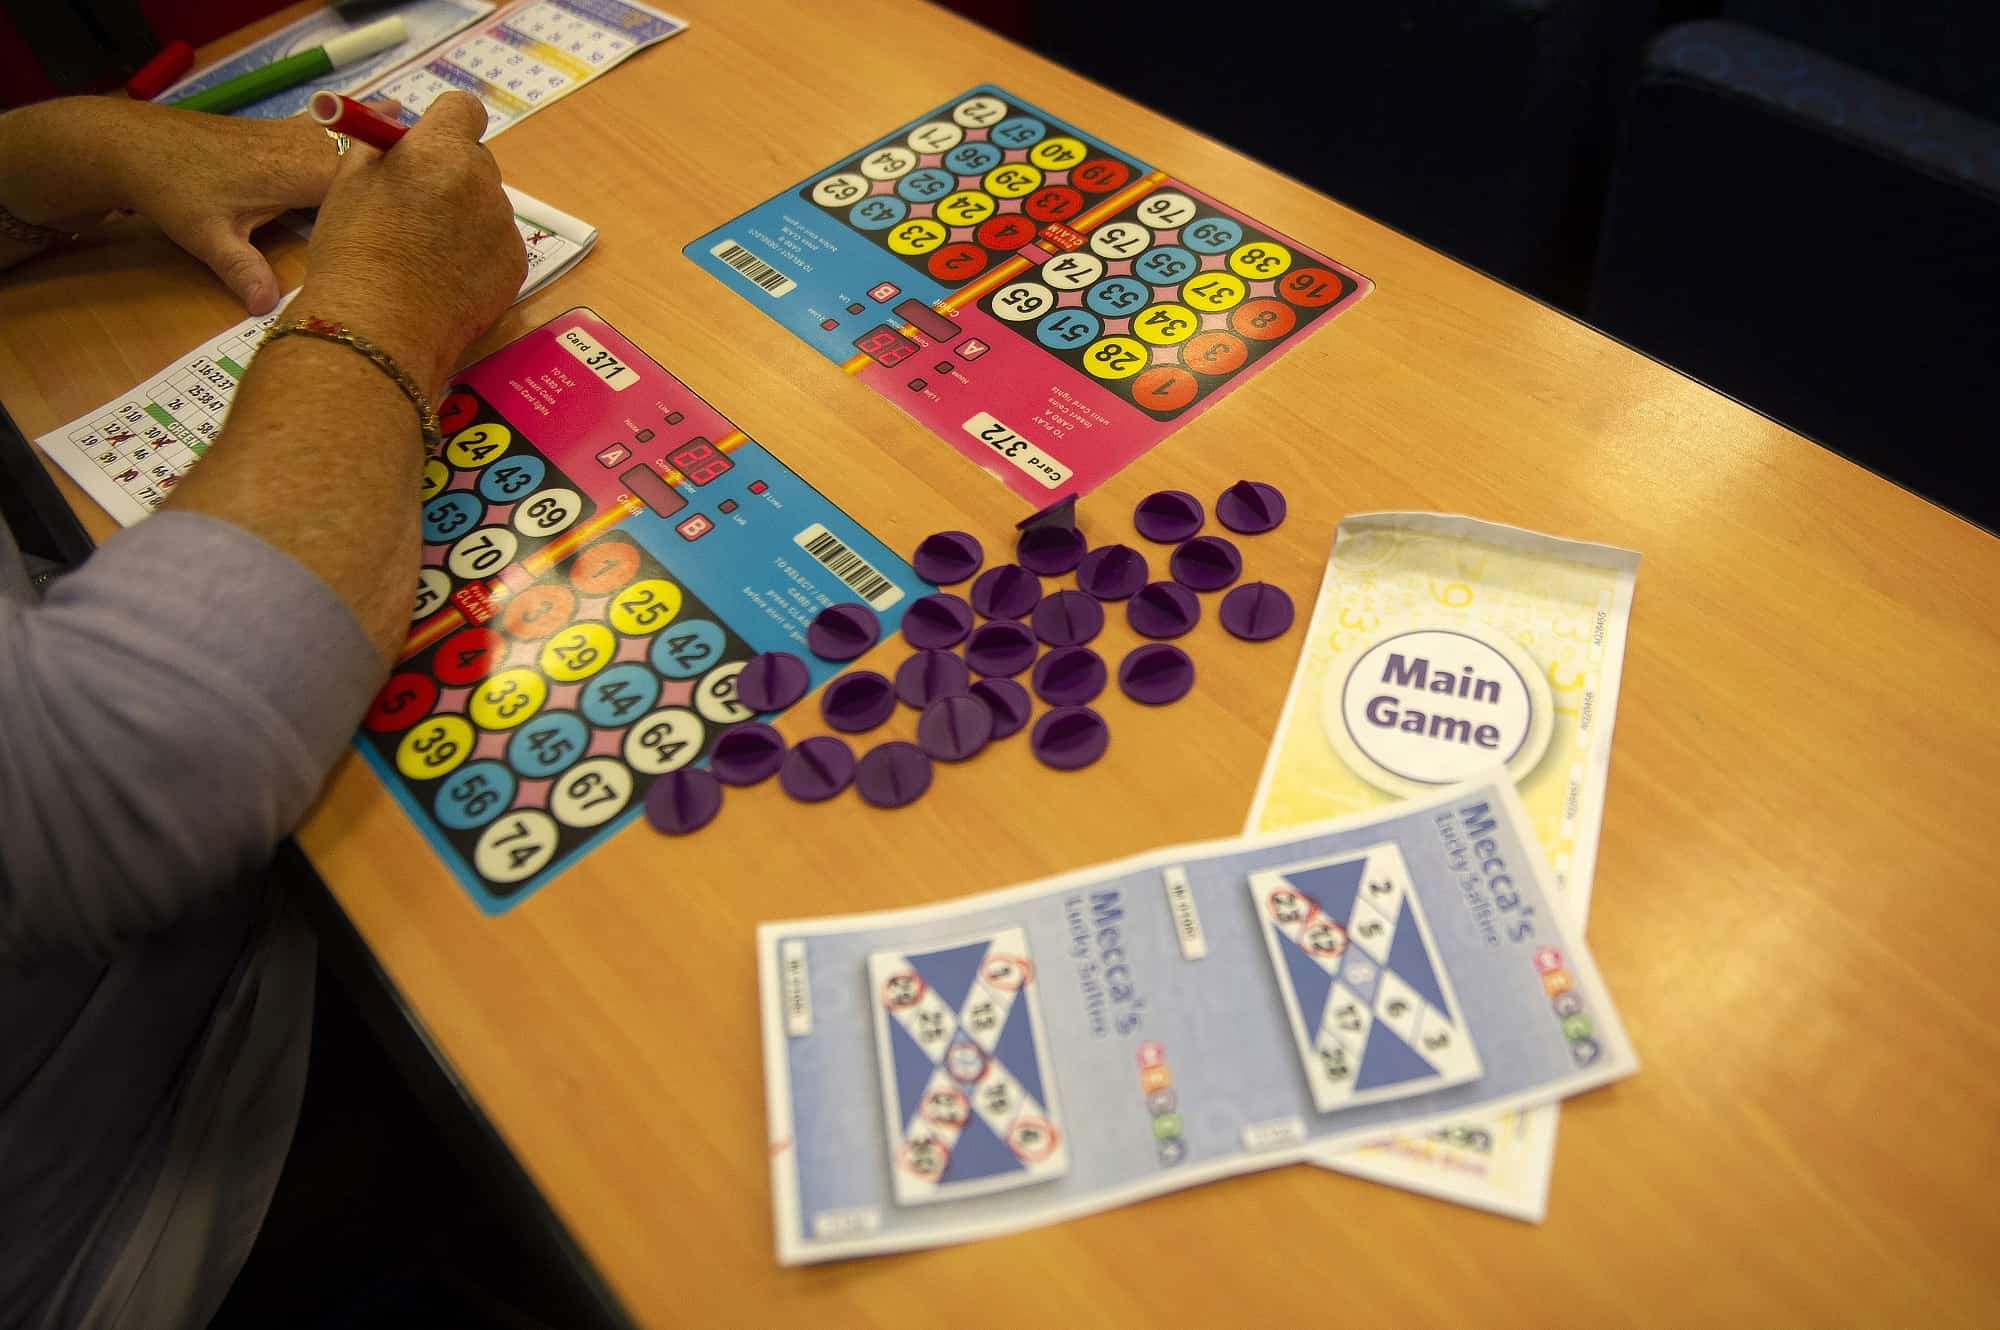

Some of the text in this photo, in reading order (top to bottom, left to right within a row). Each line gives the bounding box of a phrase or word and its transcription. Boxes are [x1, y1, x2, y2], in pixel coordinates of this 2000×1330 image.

[962, 102, 997, 124] 72
[918, 127, 953, 149] 71
[999, 124, 1036, 143] 57
[871, 152, 907, 173] 64
[955, 147, 991, 169] 56
[1040, 144, 1075, 163] 40
[909, 173, 945, 196] 52
[995, 170, 1033, 192] 29
[1081, 165, 1115, 186] 19
[823, 178, 859, 201] 62
[860, 201, 895, 222] 43
[947, 196, 987, 219] 24
[1035, 192, 1070, 214] 13
[1146, 199, 1185, 224] 76
[899, 225, 939, 248] 23
[994, 224, 1019, 238] 4
[1047, 223, 1083, 246] CLAIM
[1099, 228, 1140, 254] 75
[1192, 223, 1233, 247] 59
[944, 251, 973, 270] 2
[1052, 257, 1093, 284] 74
[1143, 253, 1187, 278] 55
[1239, 248, 1281, 273] 38
[874, 286, 895, 300] B
[1098, 283, 1140, 309] 53
[1191, 281, 1235, 305] 37
[1289, 273, 1327, 298] 16
[1001, 288, 1043, 314] 65
[1047, 315, 1090, 342] 51
[1144, 310, 1188, 337] 34
[1251, 310, 1278, 329] 8
[244, 329, 256, 337] 8
[565, 331, 627, 381] Card 371
[859, 333, 915, 365] 25
[963, 341, 985, 355] A
[1094, 343, 1140, 372] 28
[1203, 343, 1230, 362] 3
[192, 359, 235, 391] 1 16 22 37
[541, 374, 558, 389] CARD
[551, 367, 576, 388] TO PLAY
[188, 385, 225, 412] 25 38 47
[1071, 399, 1091, 413] Card
[119, 405, 132, 414] 9
[126, 411, 143, 423] 10
[145, 426, 162, 439] 30
[168, 399, 184, 410] 26
[197, 422, 214, 434] 58
[1032, 415, 1065, 439] TO PLAY
[1044, 408, 1074, 430] CARD A
[167, 422, 200, 448] GREEN
[455, 431, 499, 462] 24
[104, 423, 121, 435] 12
[133, 448, 150, 461] 46
[151, 465, 169, 477] 66
[601, 449, 625, 466] A
[980, 423, 1061, 482] Card 372
[81, 435, 99, 447] 19
[99, 451, 117, 464] 39
[138, 487, 157, 499] 77
[493, 466, 532, 494] 43
[426, 501, 468, 534] 53
[527, 497, 567, 529] 69
[682, 518, 707, 537] B
[460, 535, 502, 571] 70
[591, 559, 620, 579] 1
[456, 590, 490, 623] CLAIM
[520, 600, 553, 625] 3
[619, 586, 670, 626] 25
[457, 648, 486, 668] 4
[553, 635, 599, 672] 29
[667, 633, 711, 670] 42
[1381, 652, 1502, 705] Main
[383, 690, 414, 713] 5
[483, 684, 530, 720] 33
[599, 681, 643, 717] 44
[711, 674, 745, 713] 62
[1365, 695, 1501, 750] Game
[412, 727, 458, 768] 39
[527, 728, 574, 767] 45
[639, 722, 689, 764] 64
[450, 774, 499, 818] 56
[567, 772, 618, 810] 67
[492, 821, 542, 869] 74
[1434, 811, 1468, 873] Lucky
[1459, 800, 1535, 944] Mecca's
[1369, 878, 1392, 896] 2
[1089, 891, 1148, 1037] Mecca's
